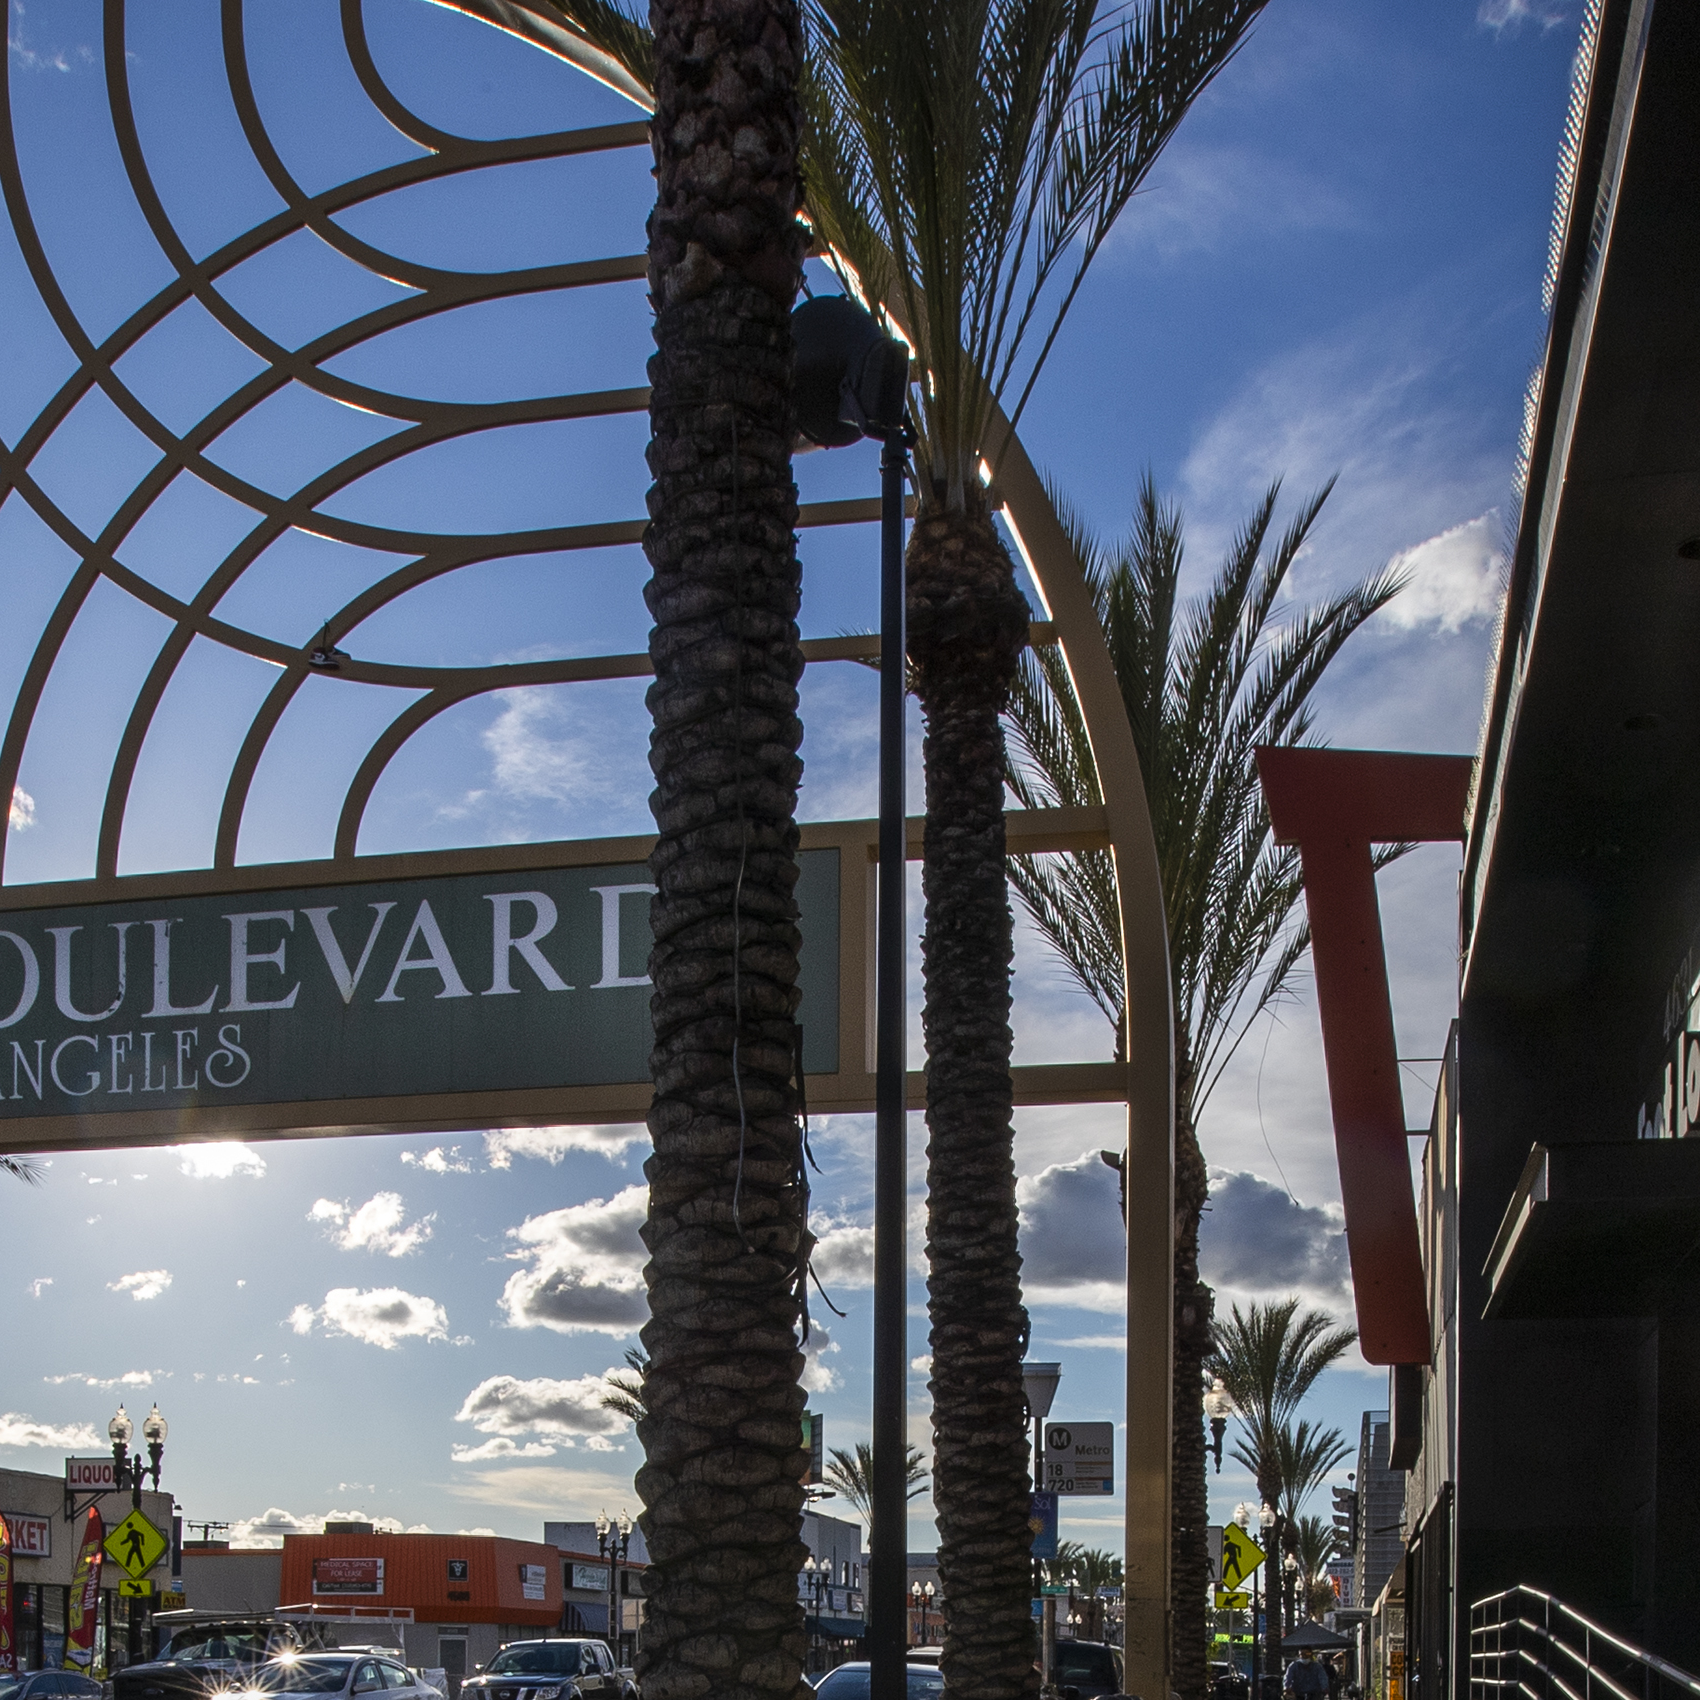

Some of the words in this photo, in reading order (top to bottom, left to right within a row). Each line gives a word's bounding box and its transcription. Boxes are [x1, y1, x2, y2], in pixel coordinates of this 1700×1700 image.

[1075, 1445, 1110, 1456] Metro
[69, 1465, 119, 1484] LIQUO
[1048, 1464, 1063, 1476] 18
[1048, 1479, 1074, 1491] 720
[344, 1570, 363, 1578] LEASE
[163, 1596, 186, 1606] ATM
